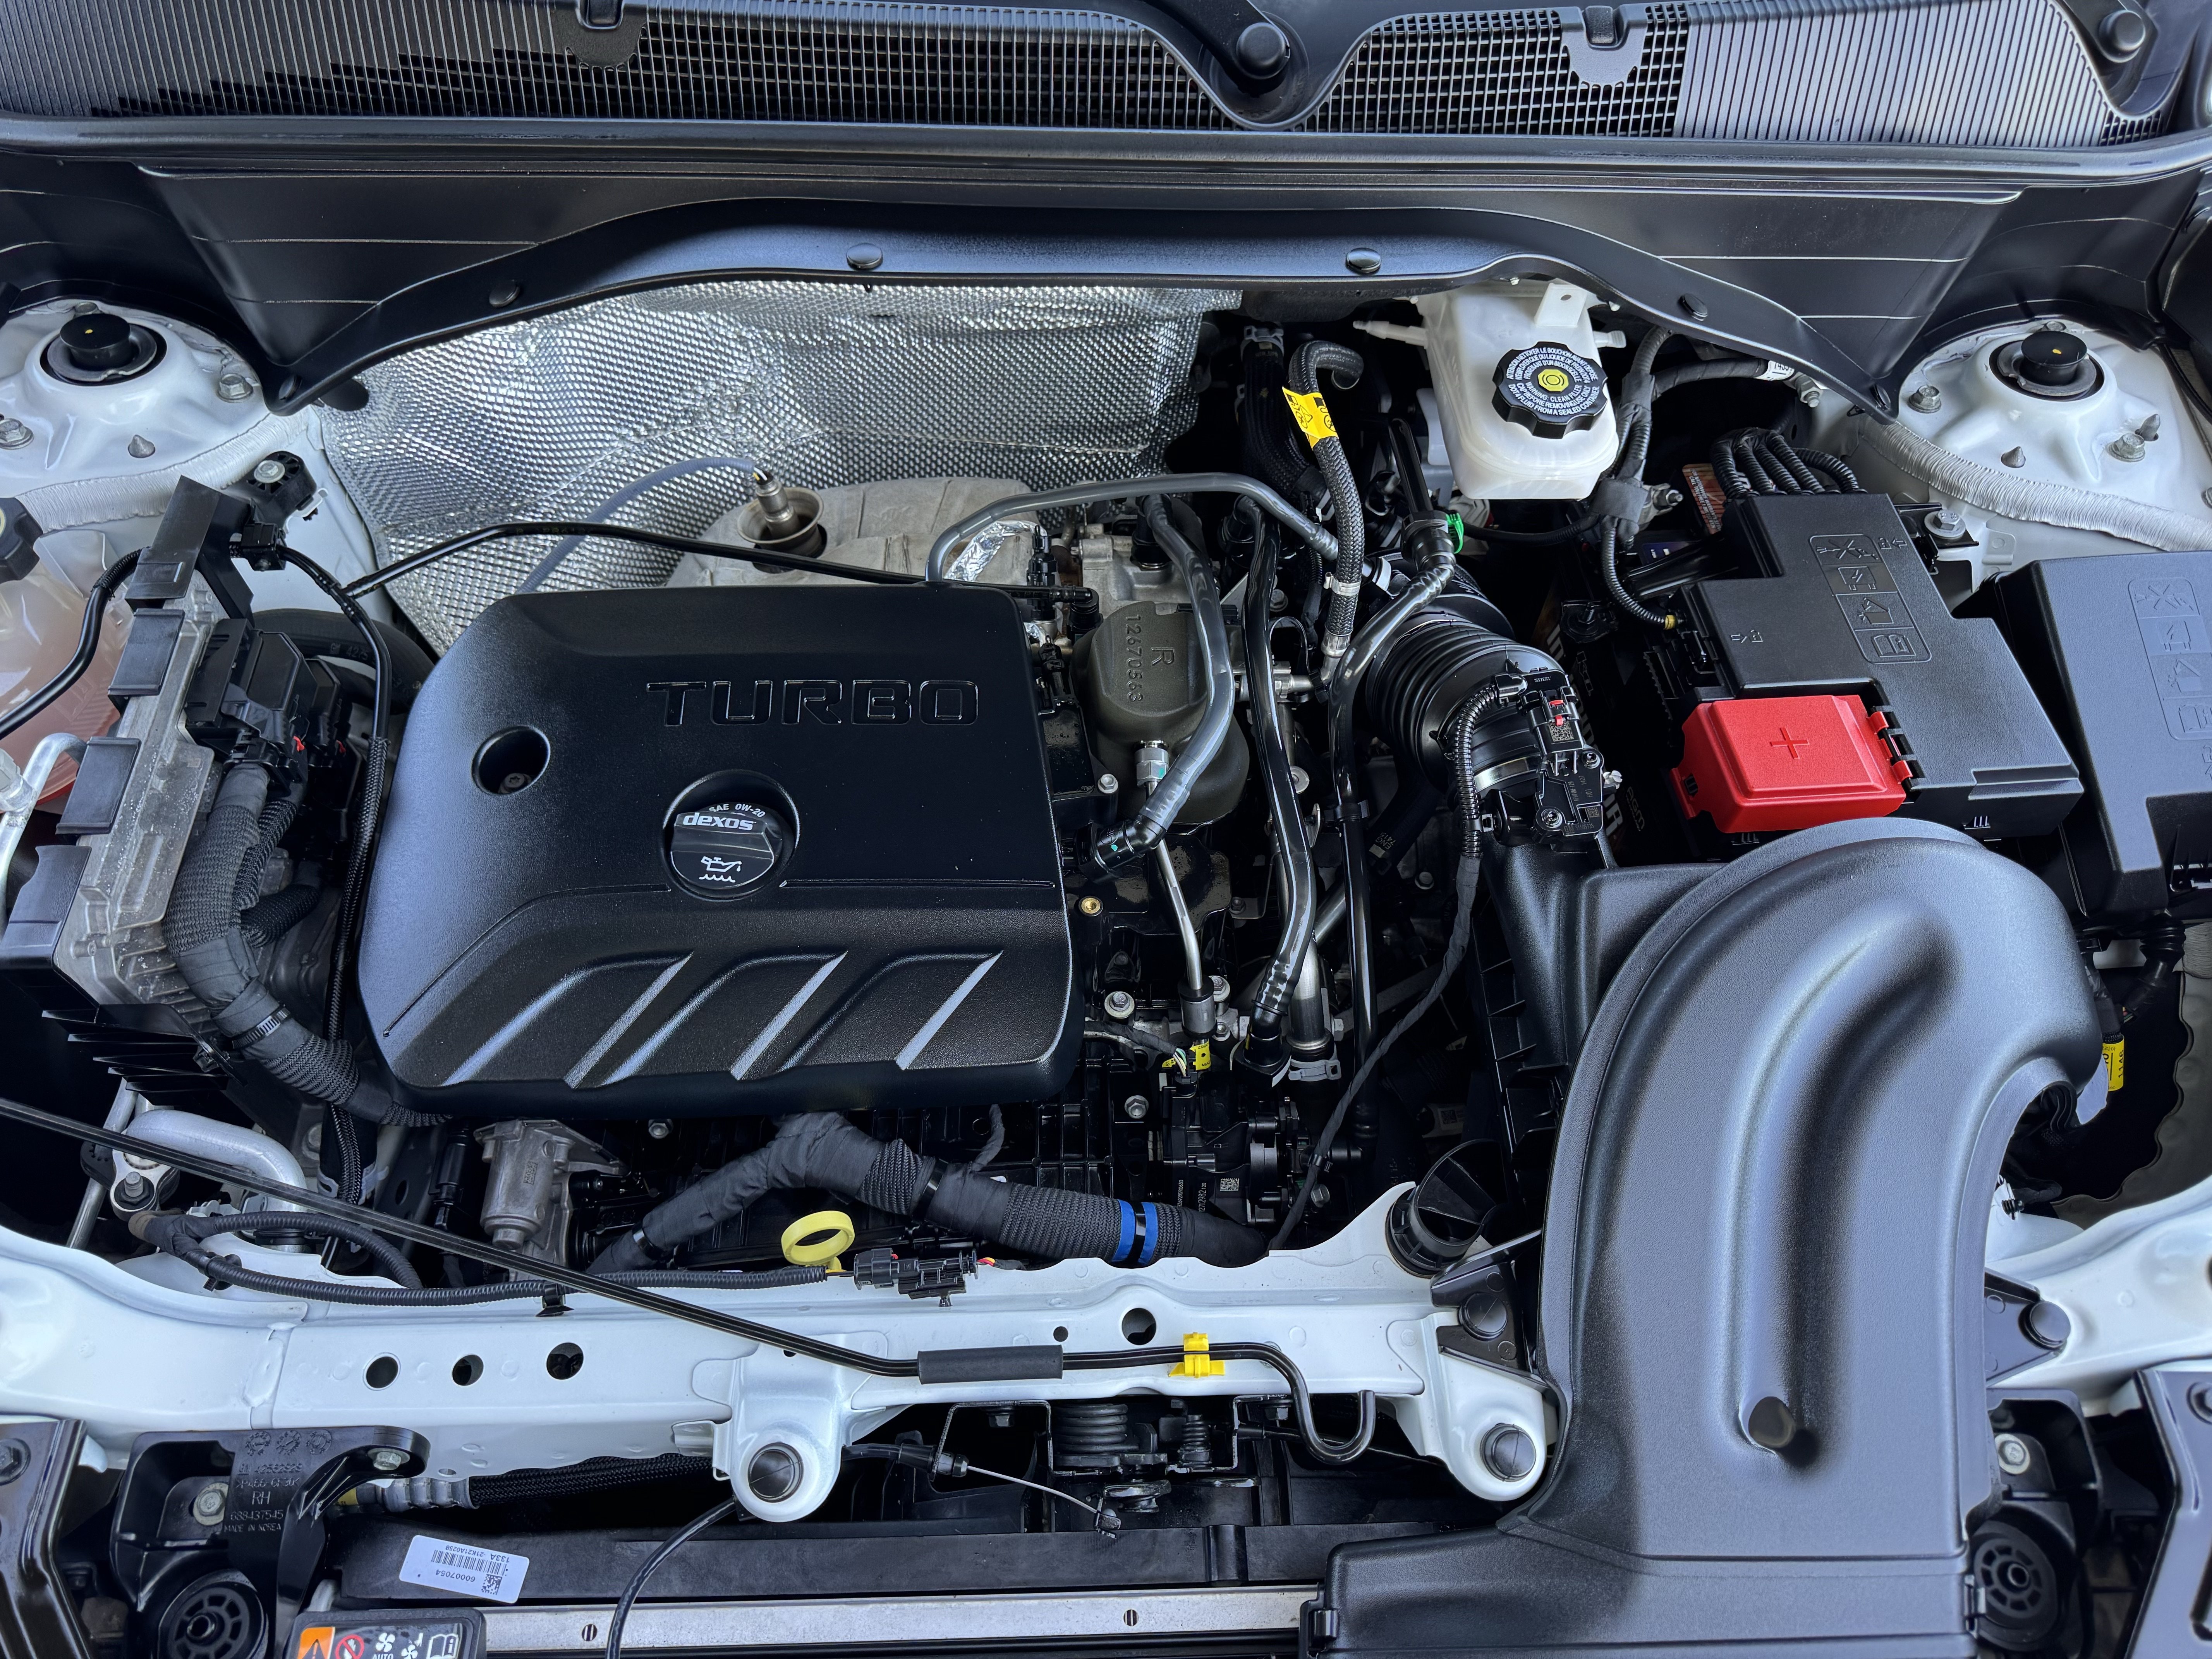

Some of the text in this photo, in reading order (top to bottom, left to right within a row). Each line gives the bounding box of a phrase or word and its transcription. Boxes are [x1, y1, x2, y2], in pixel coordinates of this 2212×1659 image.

[1546, 354, 1566, 362] LIQUIDE
[1547, 347, 1572, 358] BOUCHON
[1570, 355, 1588, 366] AVANT
[1554, 360, 1570, 370] BIDON
[1516, 383, 1527, 392] CAP
[1523, 391, 1546, 407] BEFORE
[1581, 385, 1591, 398] ONLY
[1568, 385, 1582, 399] FILLER
[1517, 395, 1535, 408] FLUID
[1534, 404, 1553, 414] FROM
[1558, 406, 1582, 416] SEALED
[1580, 386, 1600, 410] CONTAINER
[1124, 614, 1144, 702] 12670563
[1150, 646, 1176, 668] R
[646, 680, 979, 725] TURBO
[709, 804, 766, 818] SAE 0W-20
[1627, 786, 1645, 829] AGM
[683, 812, 756, 831] dexos
[251, 1491, 271, 1505] RH
[223, 1523, 281, 1533] MADE IN KOREA
[490, 1553, 510, 1563] 133A
[435, 1569, 476, 1582] 60007054
